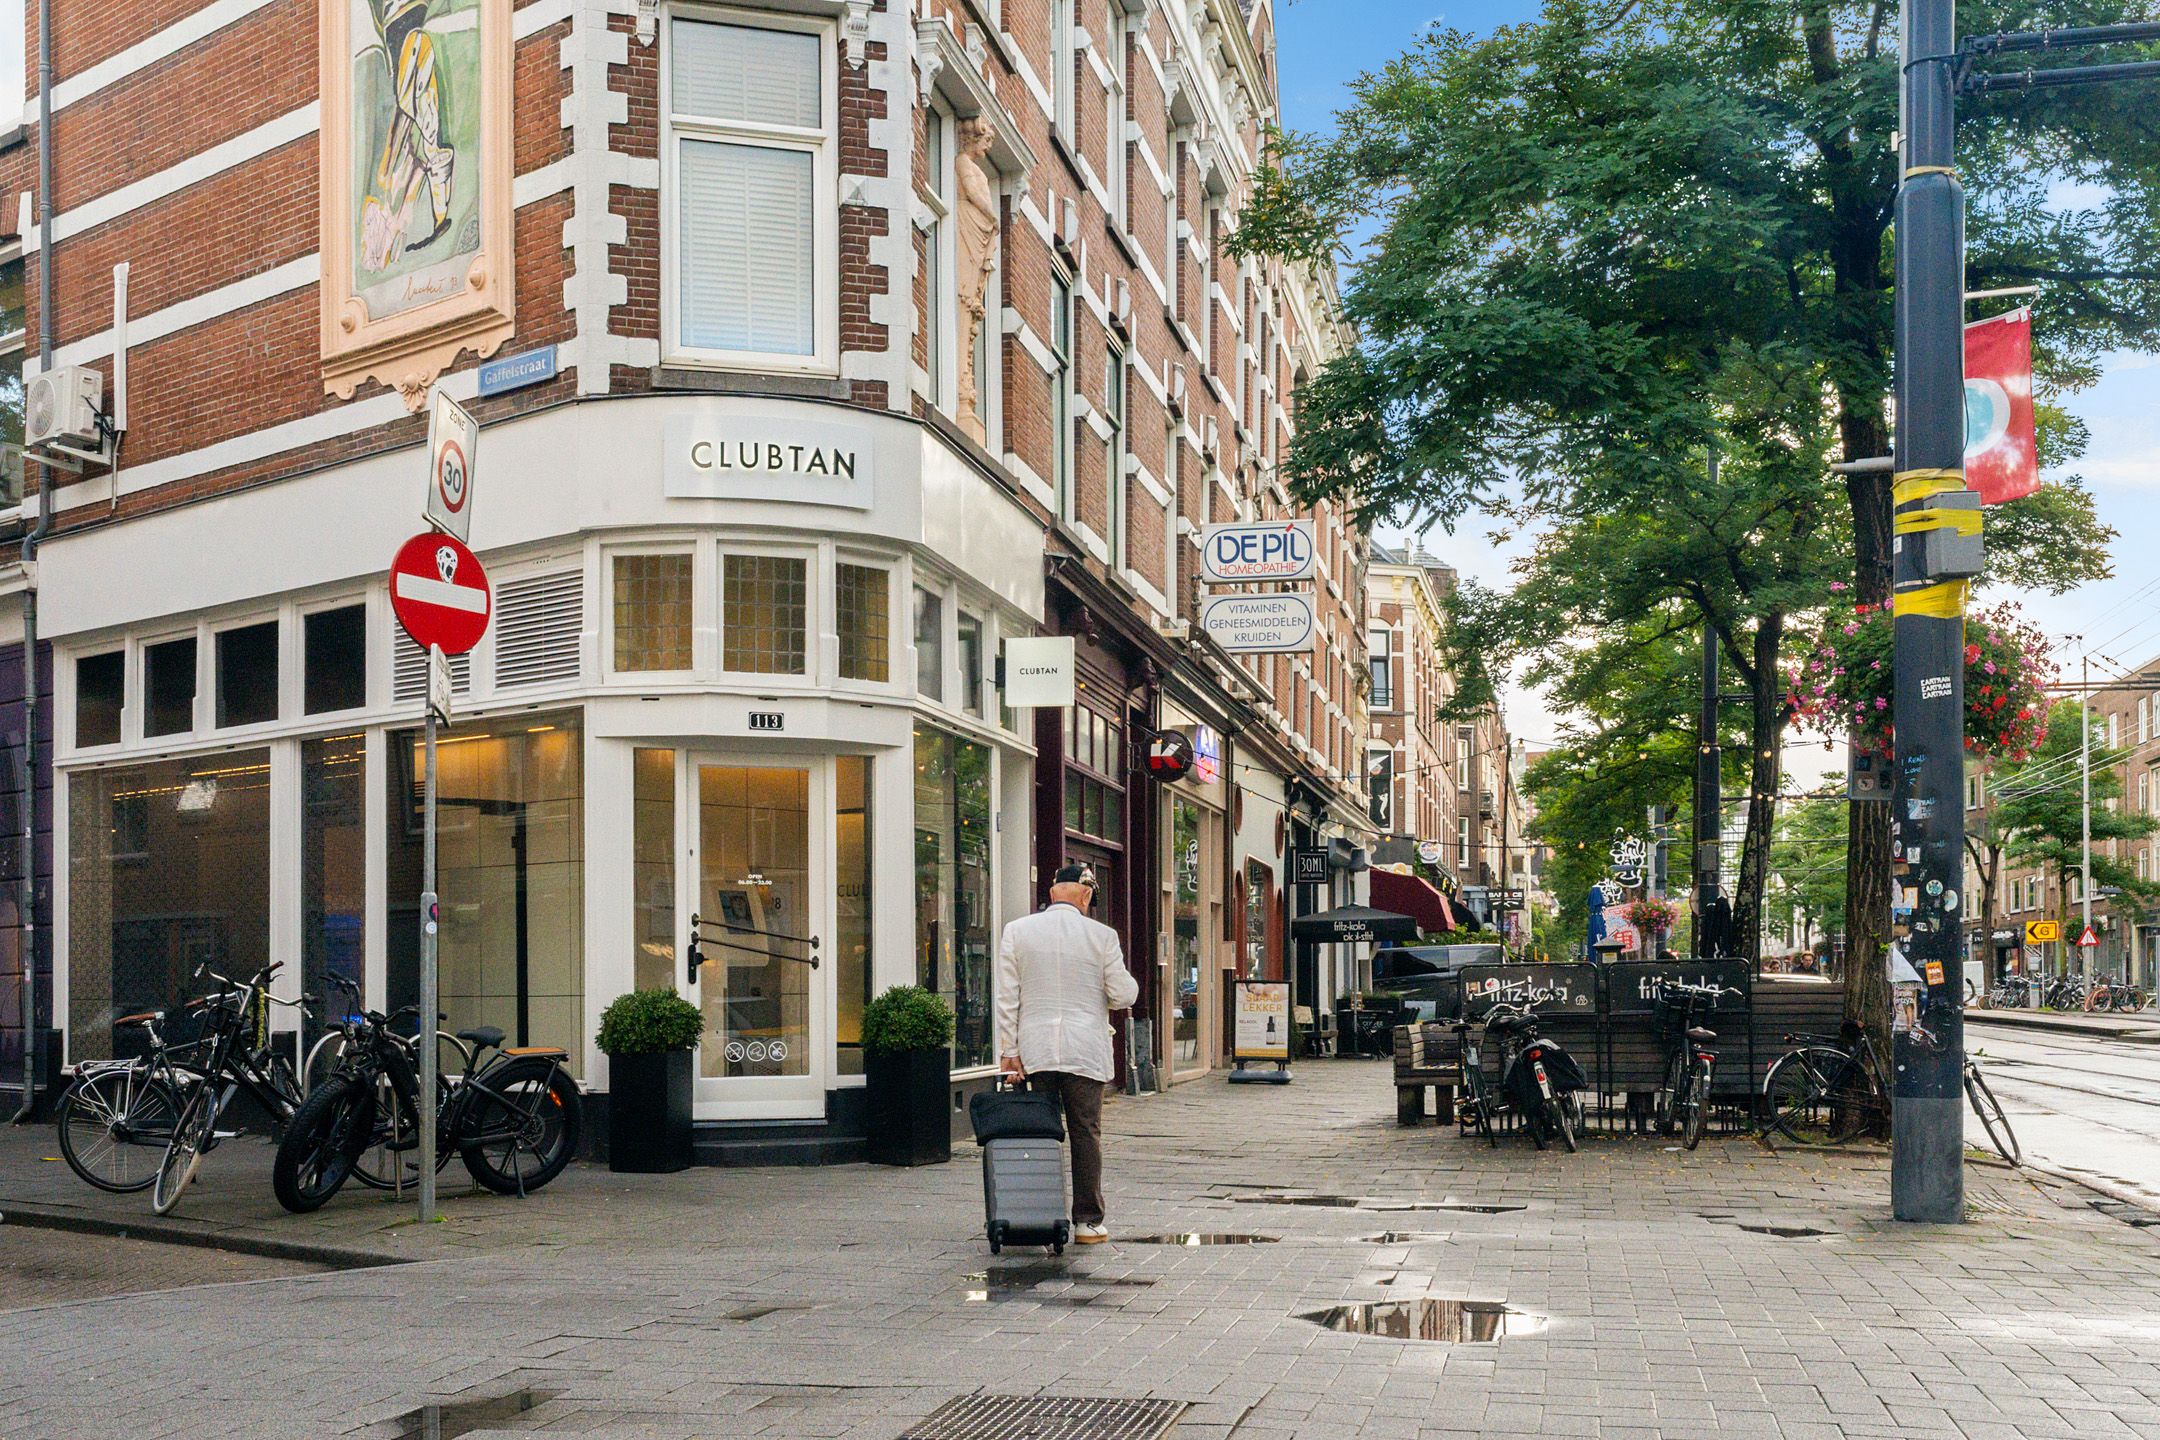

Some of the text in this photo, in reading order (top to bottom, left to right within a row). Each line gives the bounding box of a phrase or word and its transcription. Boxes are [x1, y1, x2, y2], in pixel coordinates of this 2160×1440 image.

[484, 358, 547, 385] Gaffelstraat
[449, 409, 466, 431] ZONE
[691, 441, 855, 480] CLUBTAN
[444, 460, 461, 494] 30
[1219, 562, 1297, 575] HOMEOPATHIE
[1228, 603, 1287, 614] VITAMINEN
[1209, 616, 1306, 630] GENEESMIDDELEN
[1234, 631, 1281, 642] KRUIDEN
[1019, 667, 1058, 675] CLUBTAN
[756, 714, 778, 728] 113
[1300, 857, 1324, 873] 30ML
[1333, 920, 1367, 931] fritz-kola
[1242, 1003, 1283, 1012] LEKKER
